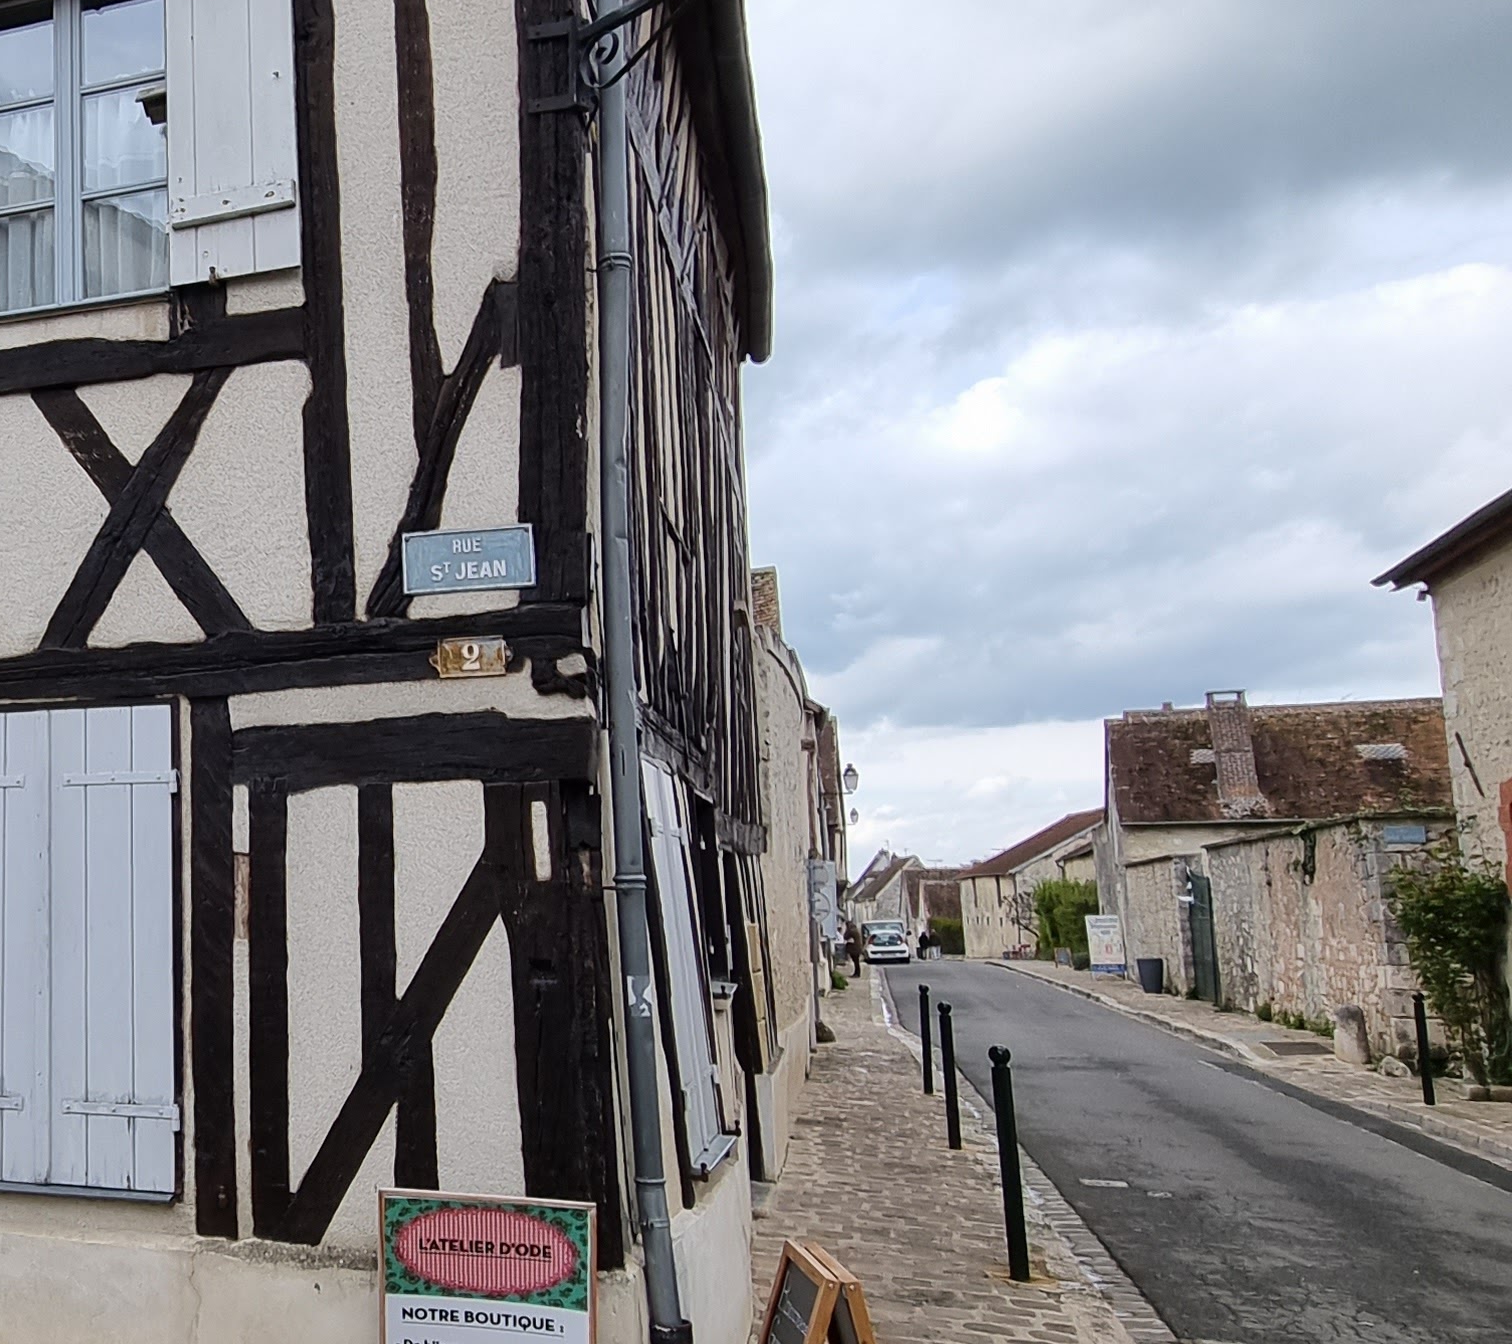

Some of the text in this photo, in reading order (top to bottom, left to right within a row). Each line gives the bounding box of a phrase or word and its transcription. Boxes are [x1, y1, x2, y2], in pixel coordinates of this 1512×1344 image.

[452, 538, 482, 554] RUE
[455, 559, 507, 581] JEAN
[460, 643, 481, 671] 2
[419, 1238, 552, 1258] L'ATELIER D'ODE
[401, 1307, 460, 1322] NOTRE
[464, 1311, 556, 1332] BOUTIQUE
